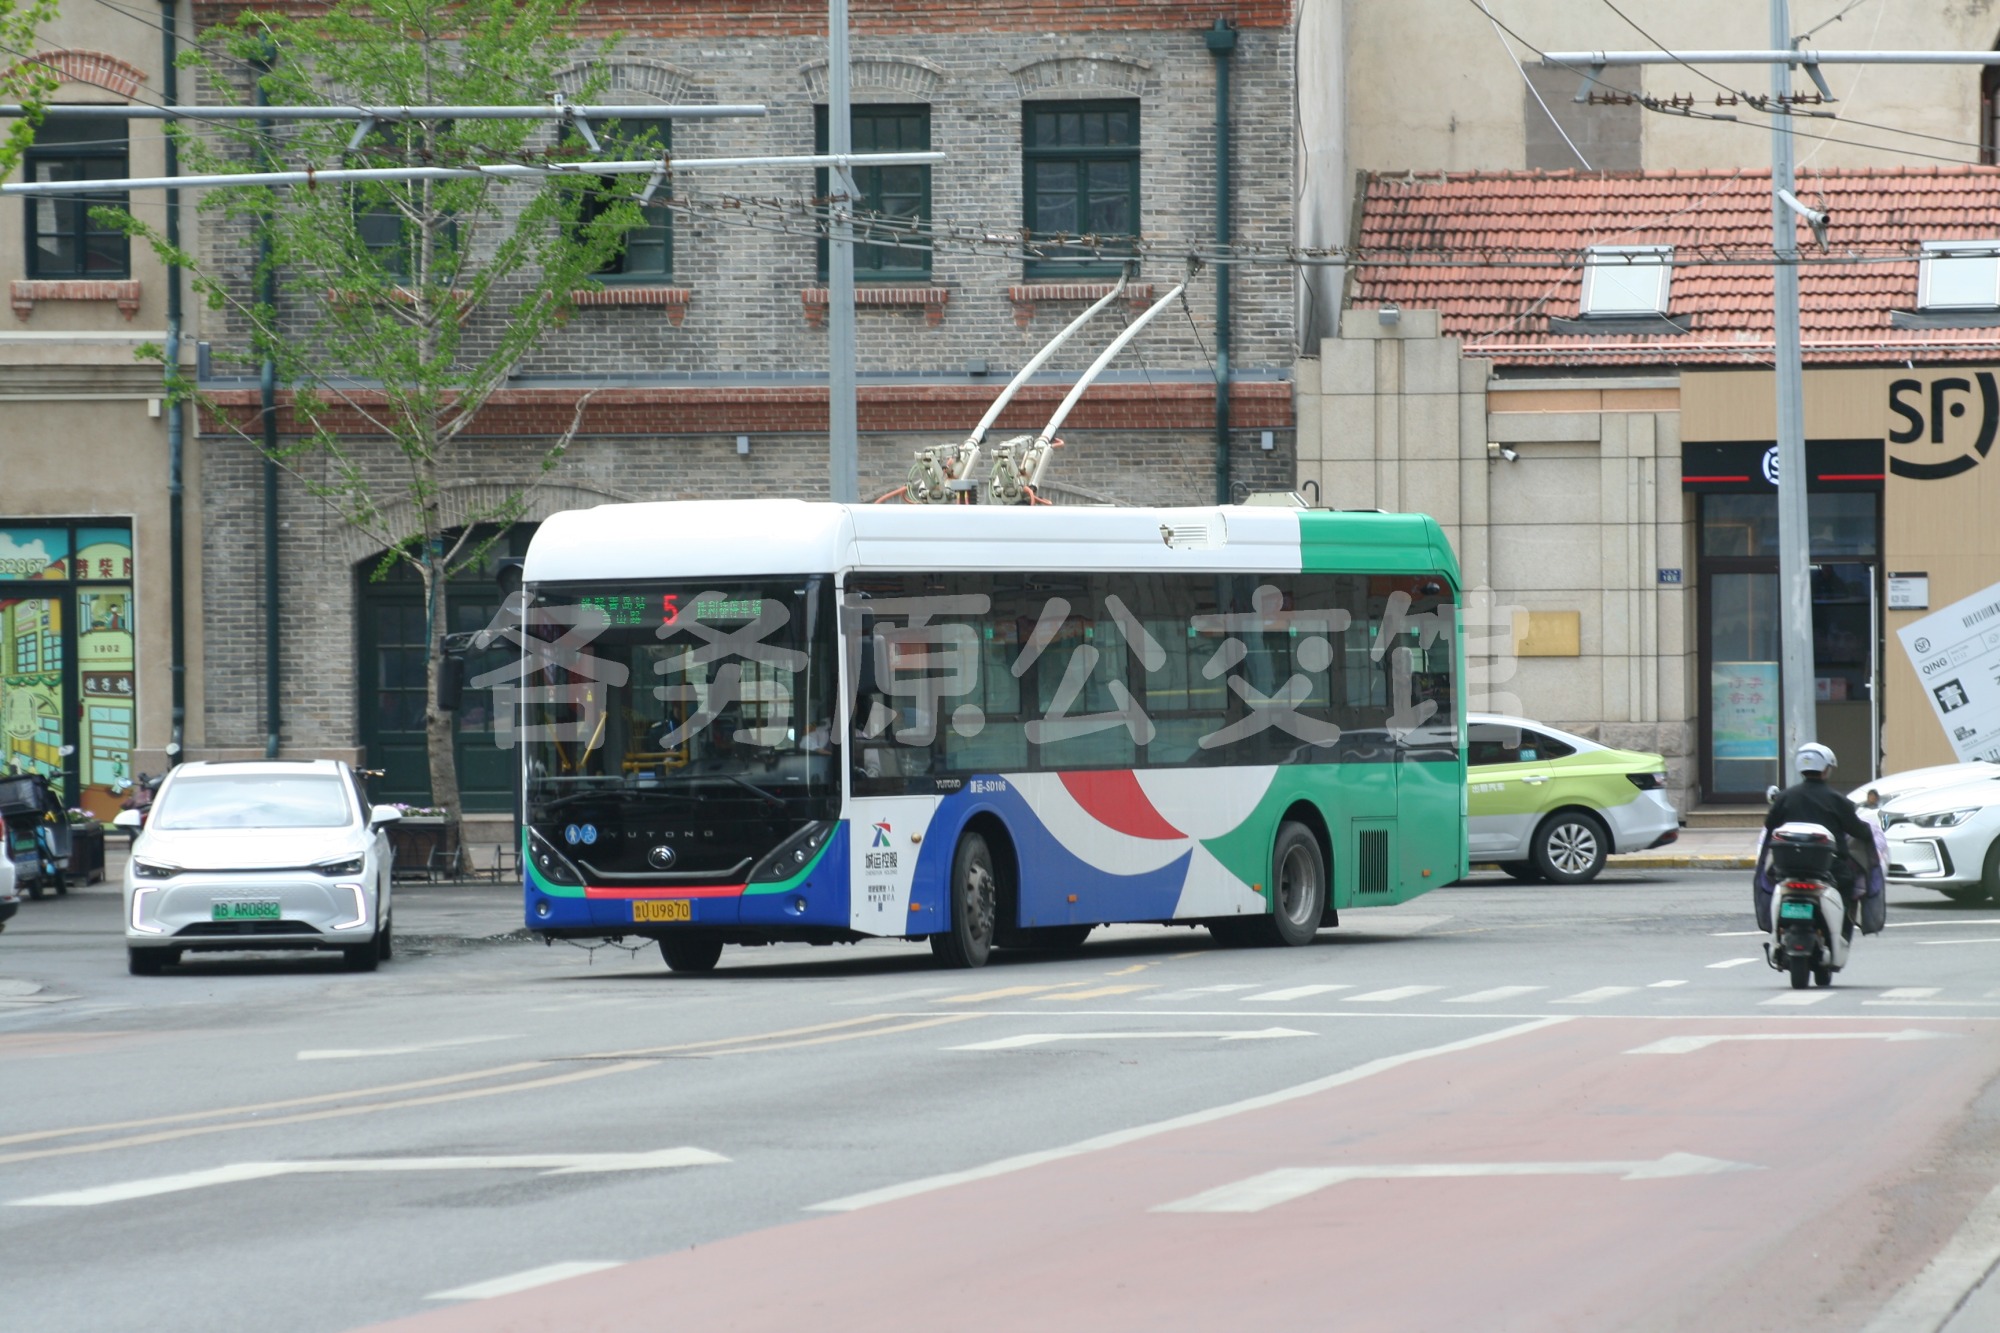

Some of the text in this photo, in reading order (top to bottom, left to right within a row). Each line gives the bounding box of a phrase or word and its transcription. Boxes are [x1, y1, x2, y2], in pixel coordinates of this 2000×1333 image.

[663, 594, 679, 626] 5
[94, 644, 120, 653] 1902
[1922, 657, 1947, 675] QING
[609, 830, 714, 838] YUTONG
[865, 851, 898, 869] 城运控股
